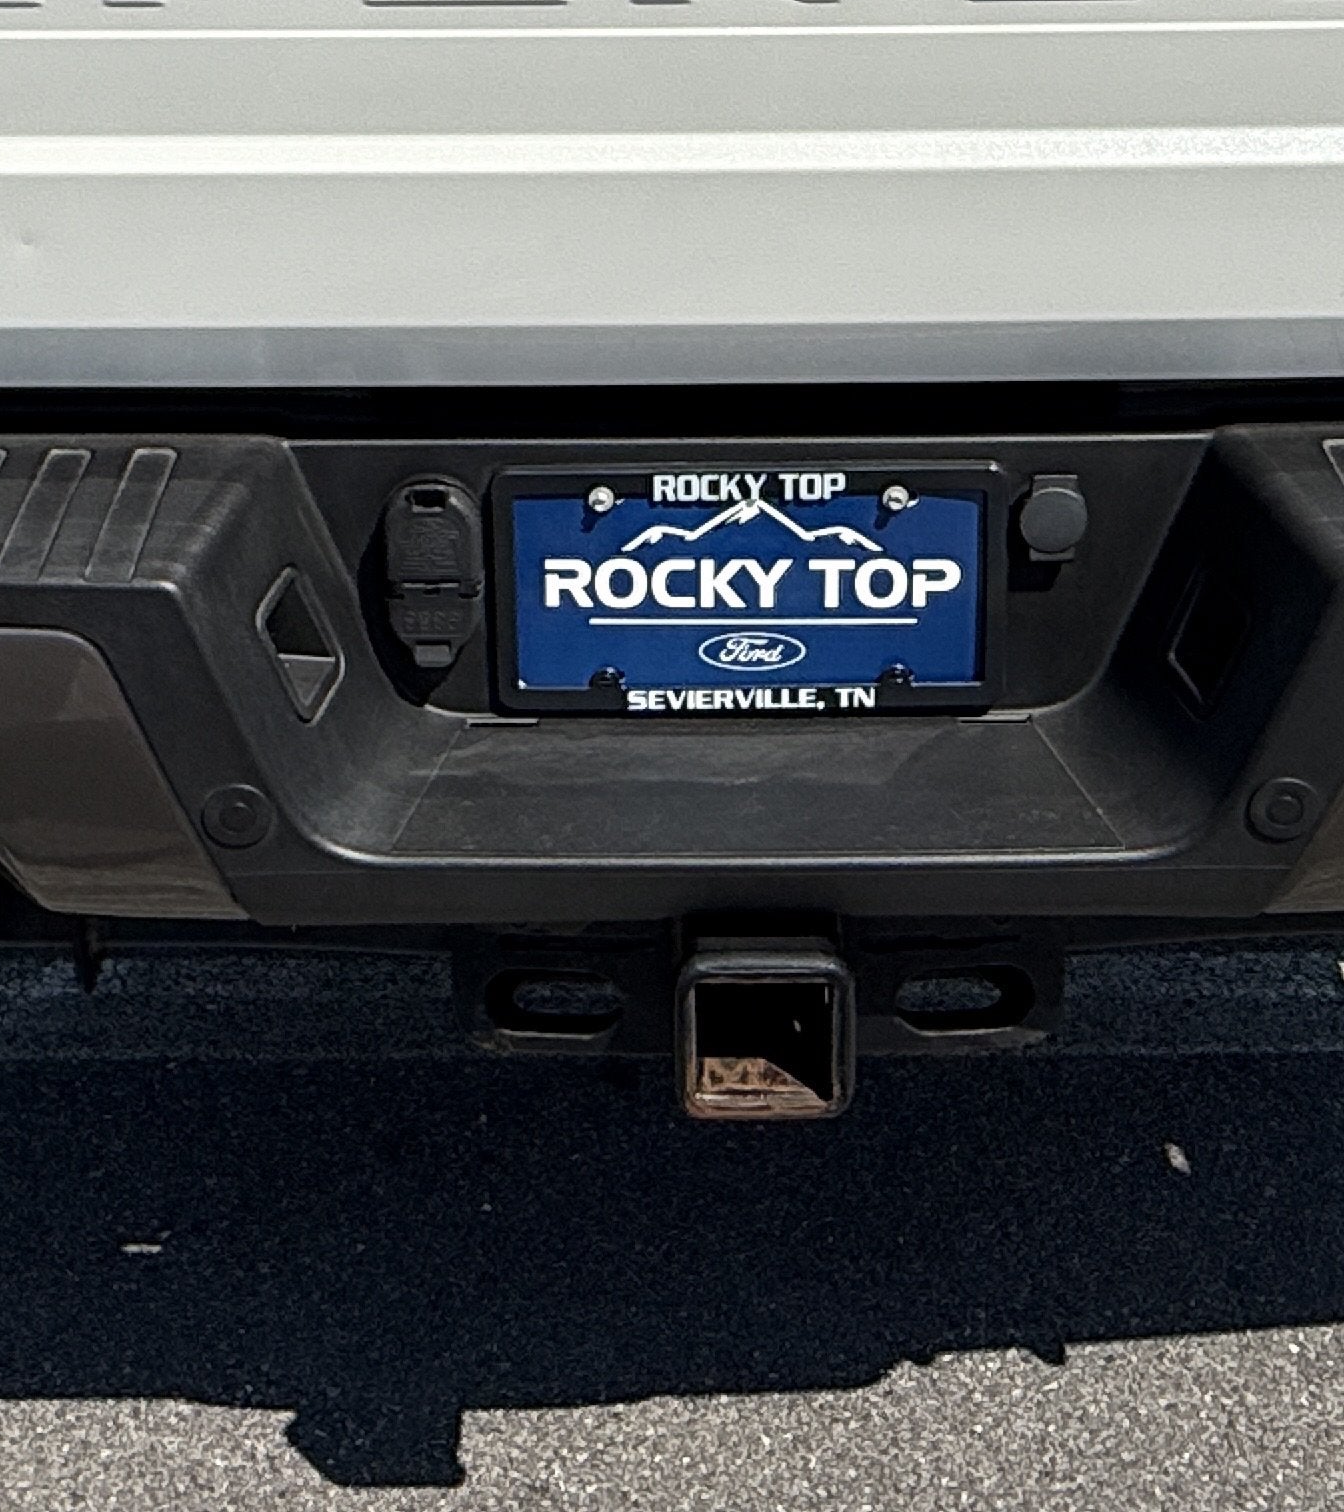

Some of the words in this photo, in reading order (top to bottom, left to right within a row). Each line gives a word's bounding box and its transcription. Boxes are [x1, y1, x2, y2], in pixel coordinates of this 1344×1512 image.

[654, 473, 767, 502] ROCKY
[778, 472, 847, 500] TOP
[544, 558, 793, 608] ROCKY
[809, 558, 962, 608] TOP
[719, 637, 783, 663] Ford
[627, 689, 826, 711] SEVIERVILLE,
[835, 688, 876, 709] TN
